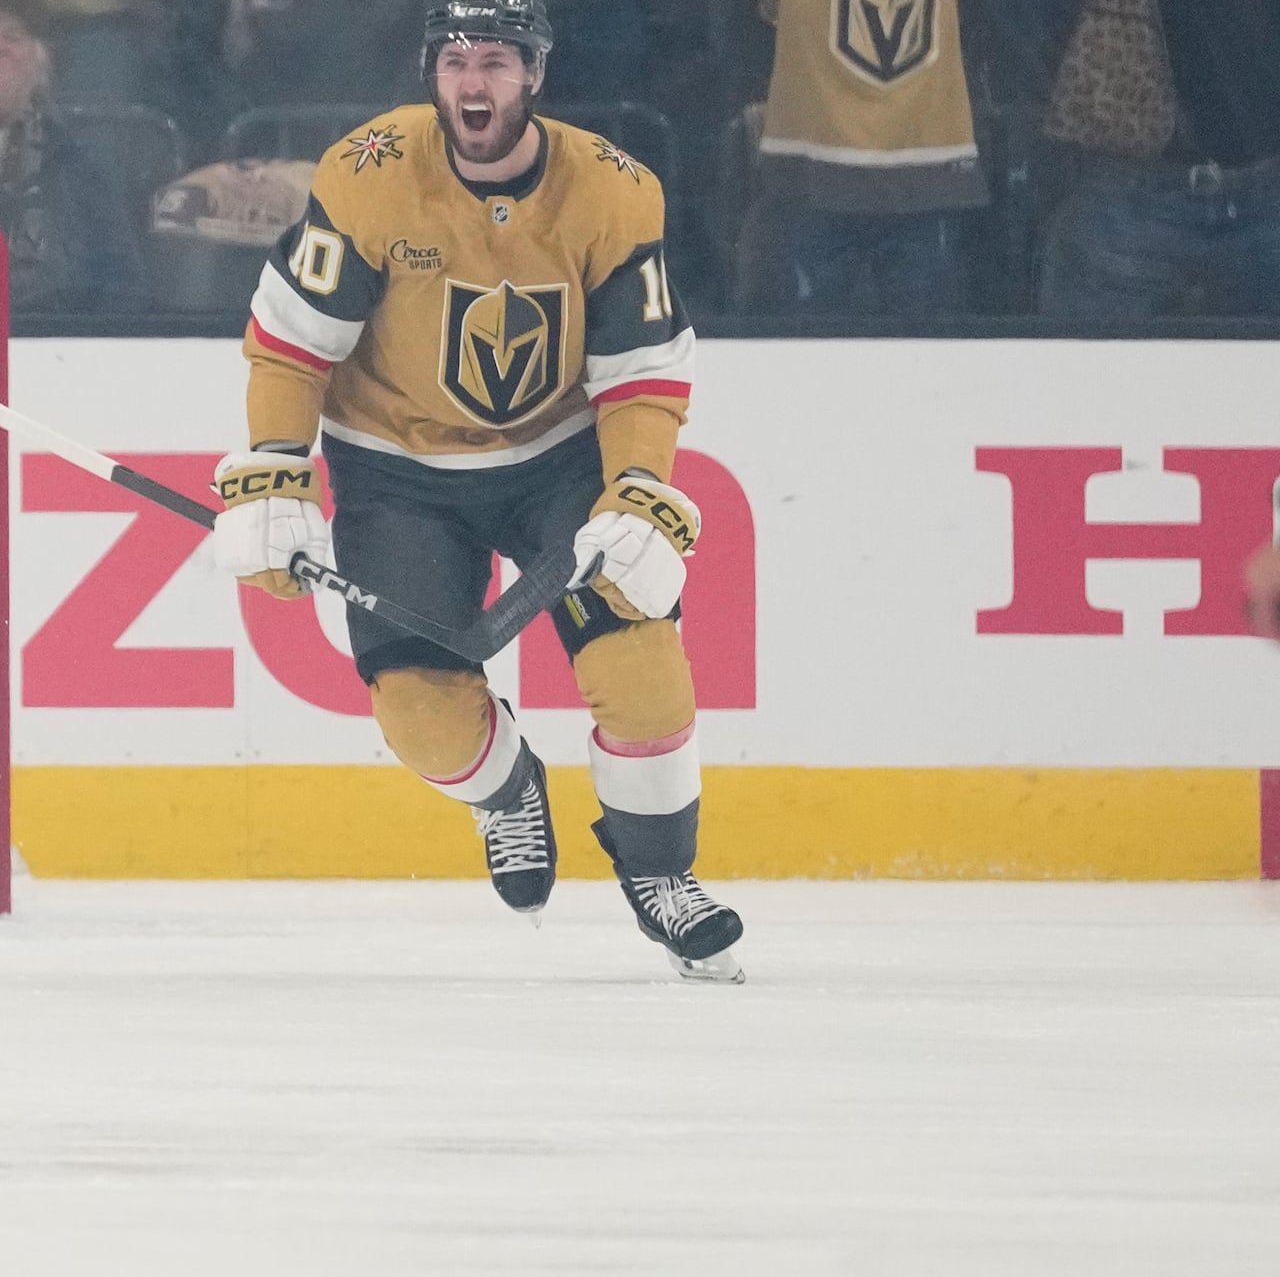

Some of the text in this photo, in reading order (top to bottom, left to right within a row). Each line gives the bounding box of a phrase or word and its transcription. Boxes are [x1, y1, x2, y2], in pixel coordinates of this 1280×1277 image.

[390, 239, 441, 263] Circa
[220, 469, 312, 501] CCM
[617, 485, 695, 552] CCM
[293, 558, 378, 612] CCM
